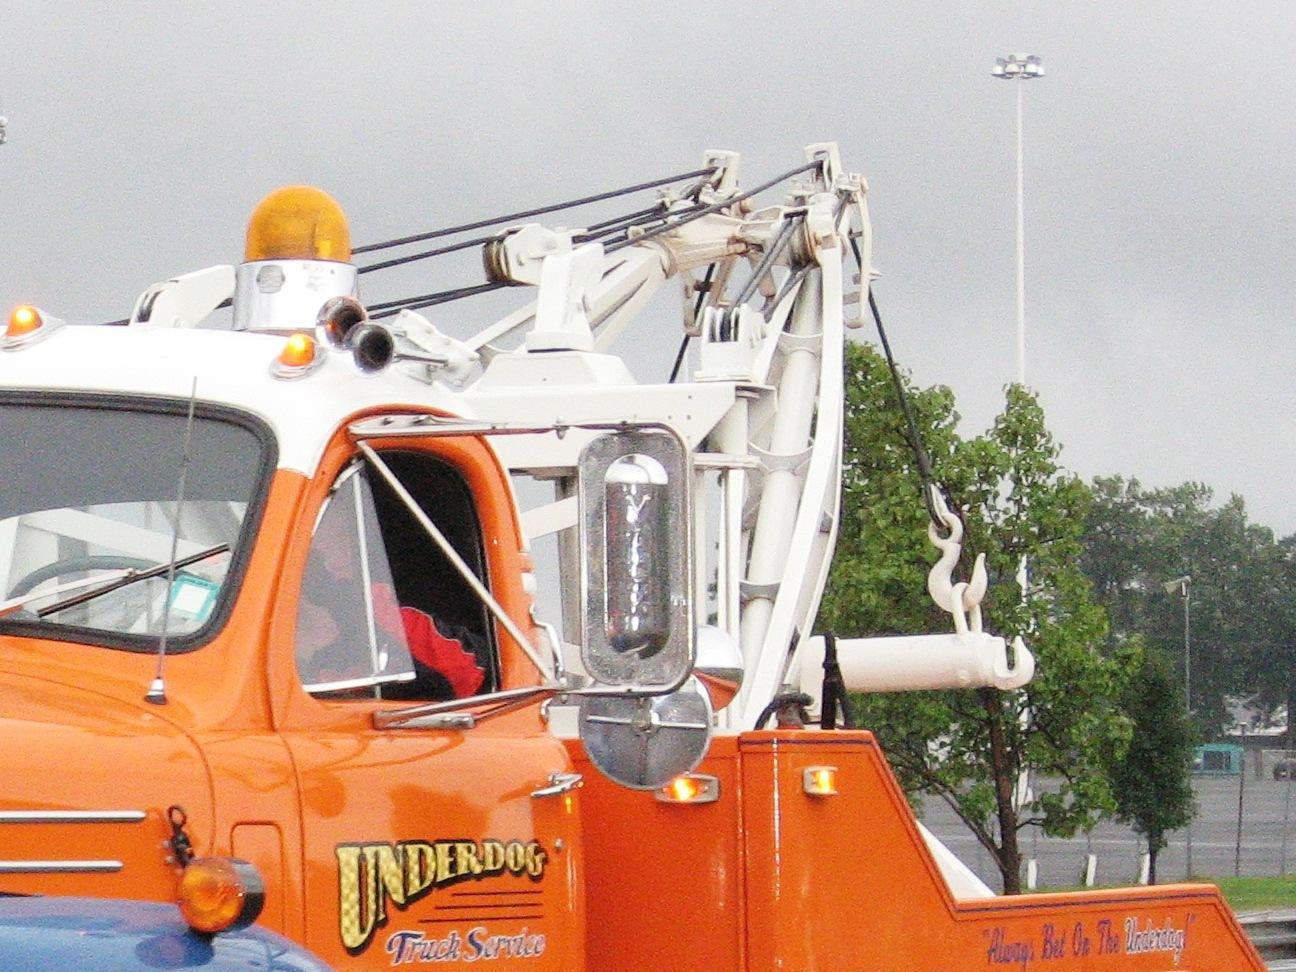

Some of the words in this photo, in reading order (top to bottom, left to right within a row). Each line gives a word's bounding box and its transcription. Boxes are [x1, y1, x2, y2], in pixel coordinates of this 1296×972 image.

[336, 839, 549, 956] UNDERDOG
[386, 929, 461, 965] Truck
[463, 927, 546, 962] Service
